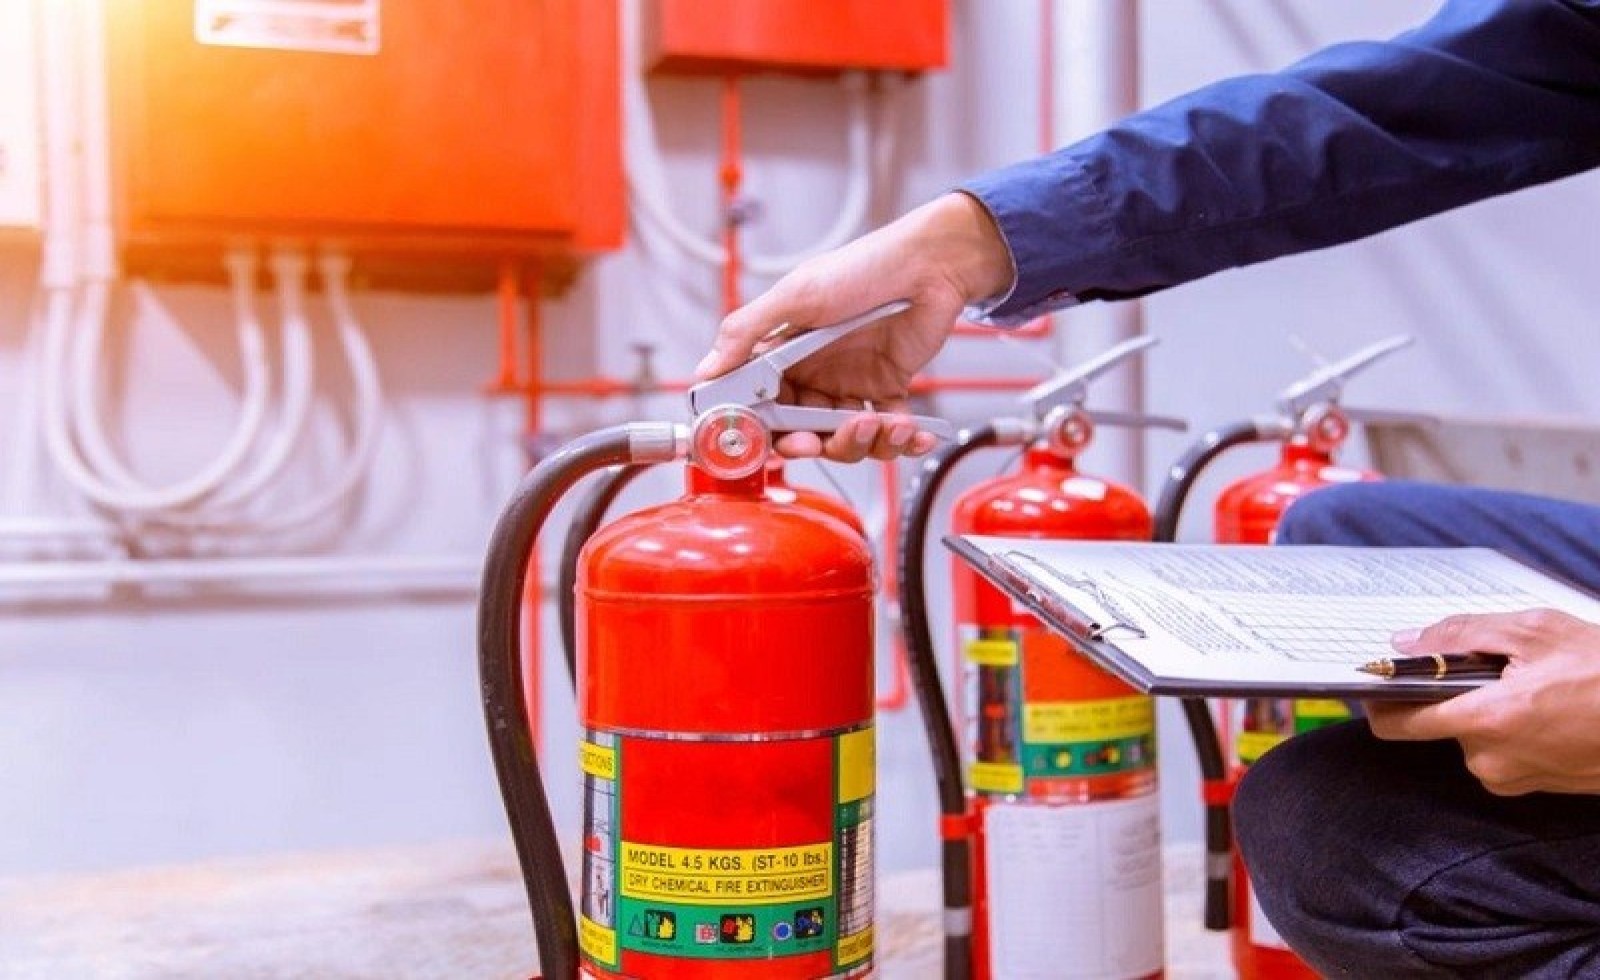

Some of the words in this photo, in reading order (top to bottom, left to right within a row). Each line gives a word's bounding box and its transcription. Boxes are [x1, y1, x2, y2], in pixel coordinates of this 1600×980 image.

[628, 848, 676, 869] MODEL
[681, 854, 703, 870] 4.5
[708, 856, 746, 870] KGS.
[752, 852, 799, 871] (ST-10
[629, 872, 649, 887] DRY
[651, 877, 710, 893] CHEMICAL
[715, 880, 742, 893] FIRE
[745, 873, 825, 893] EXTINGUISHER
